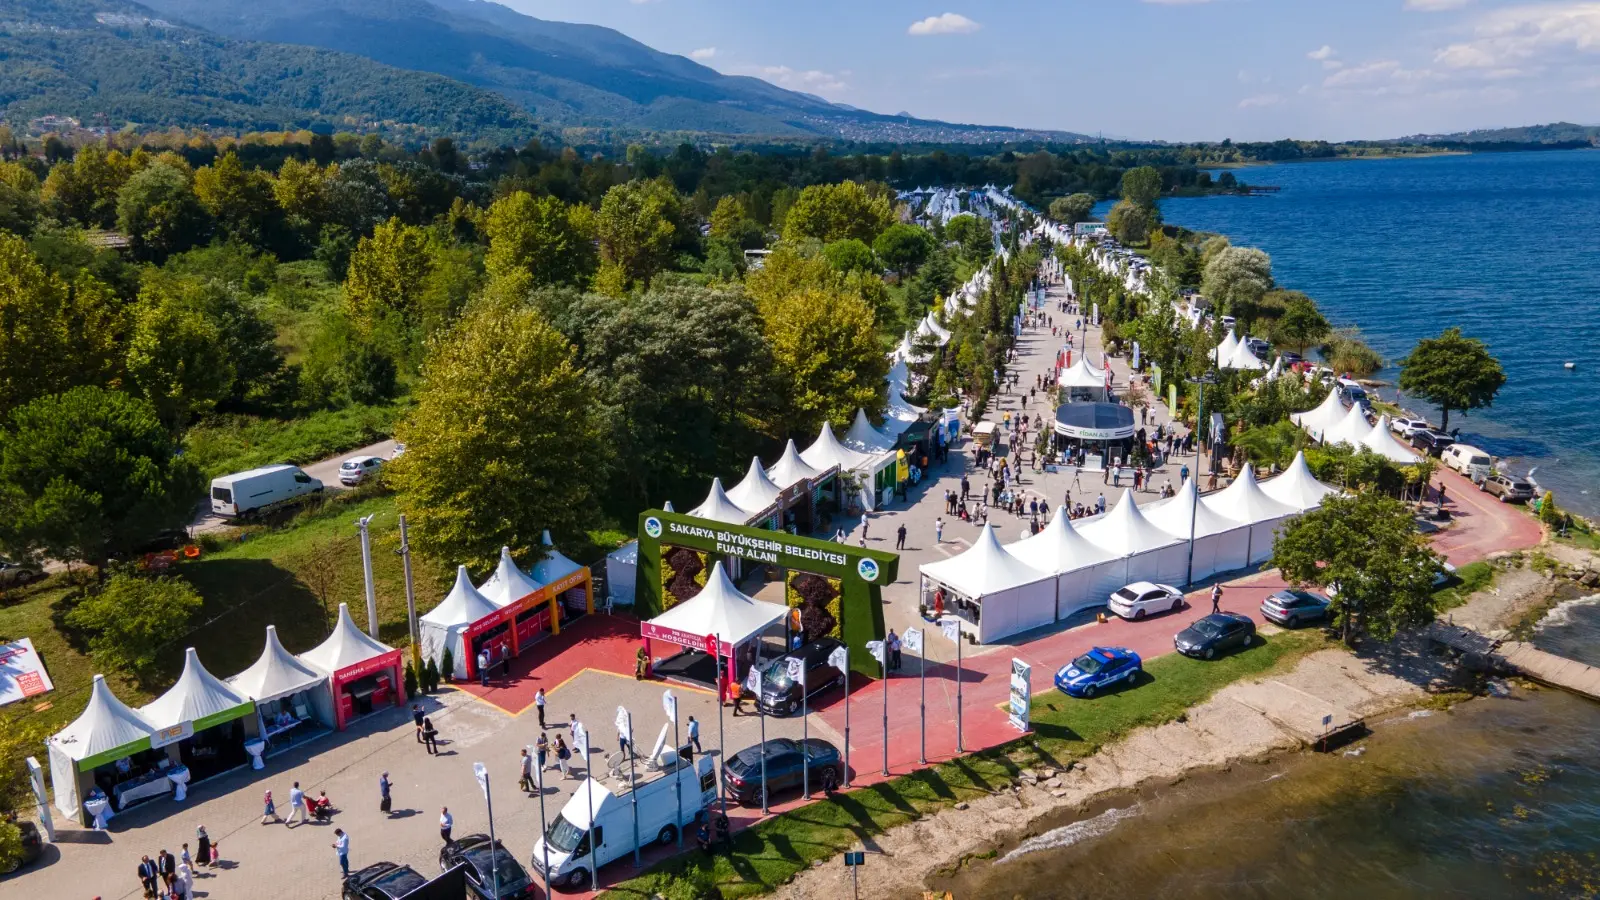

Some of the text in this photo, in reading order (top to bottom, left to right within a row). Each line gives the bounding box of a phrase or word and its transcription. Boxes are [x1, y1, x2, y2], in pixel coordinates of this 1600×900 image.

[670, 523, 847, 565] SAKARYA BÜYÜKŞEHİR BELEDİYESİ
[717, 543, 777, 562] FUAR ALANI
[662, 633, 707, 649] HOŞGELDİNİ
